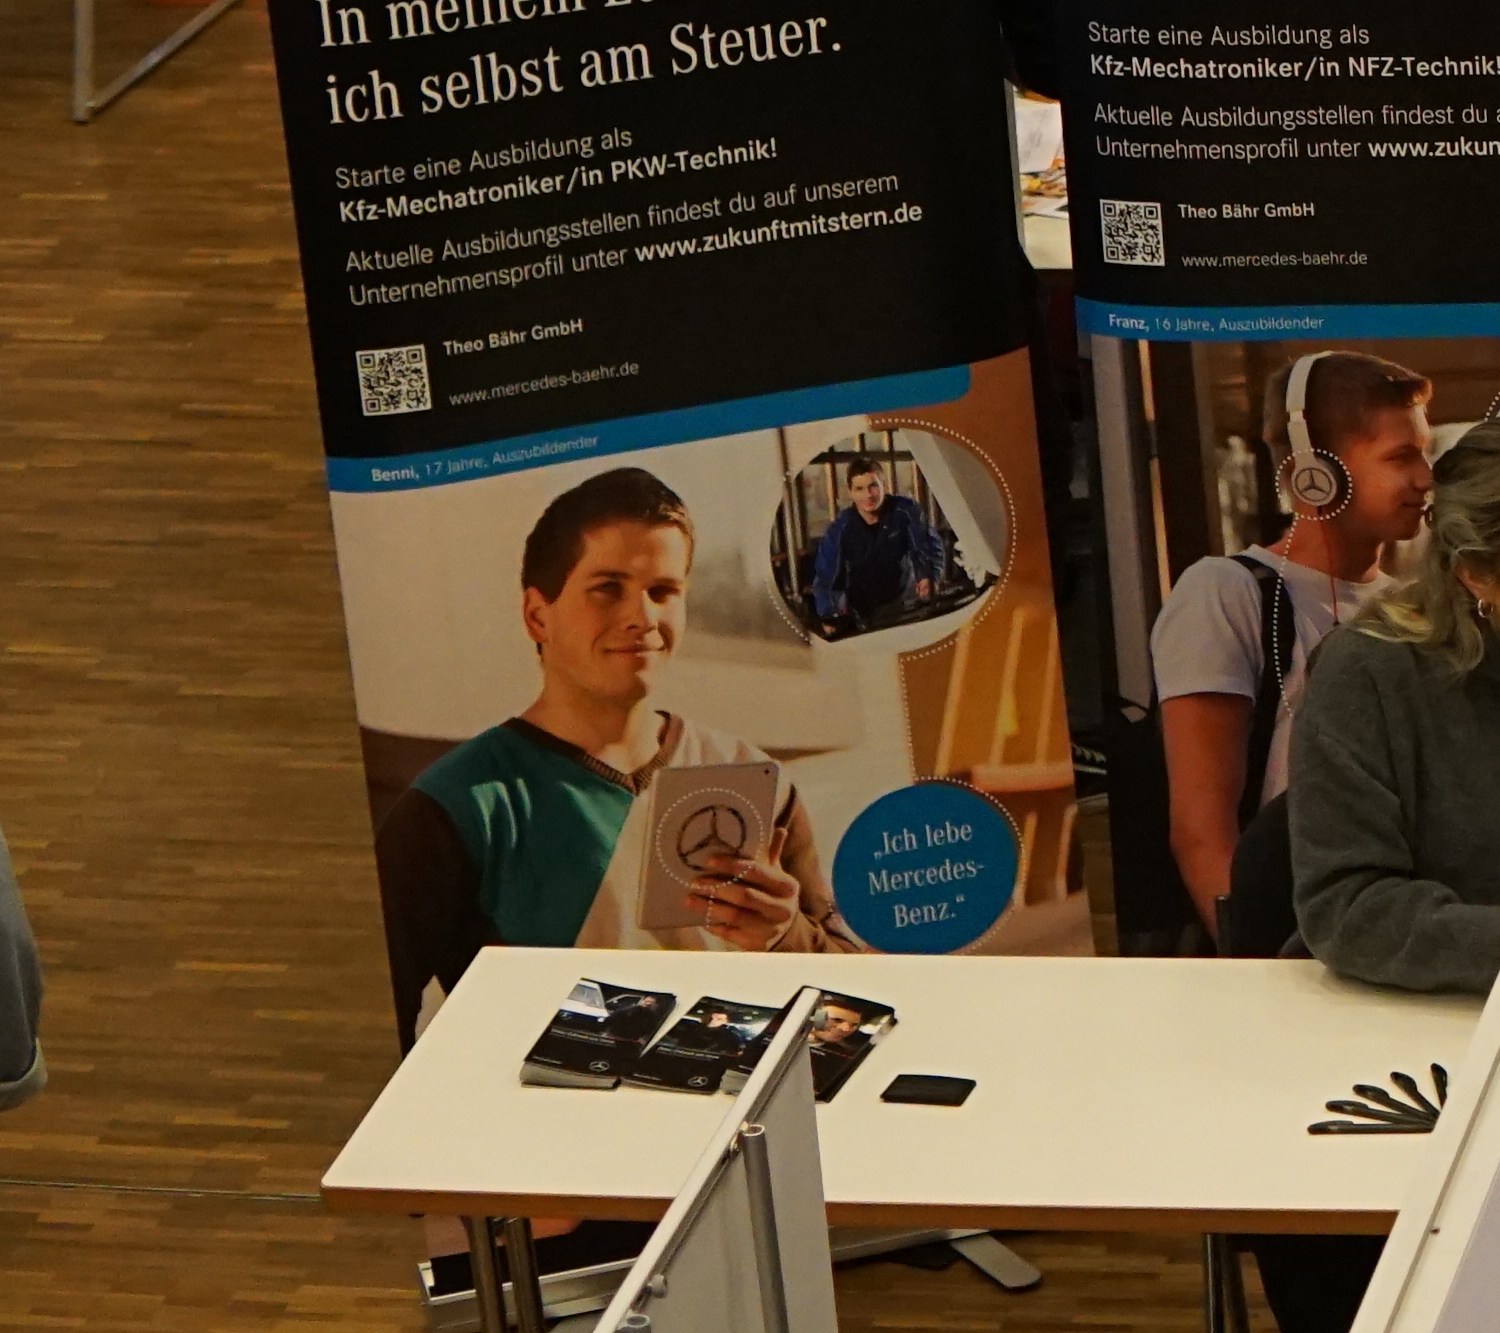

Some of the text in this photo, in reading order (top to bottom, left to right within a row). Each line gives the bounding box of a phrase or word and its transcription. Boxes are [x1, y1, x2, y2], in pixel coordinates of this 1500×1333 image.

[325, 16, 841, 124] ich selbst am Steuer.
[1090, 53, 1340, 82] Kfz-Mechatroniker/in
[335, 126, 633, 189] Starte eine Ausbildung als
[339, 136, 777, 223] Kfz-Mechatroniker/in PKW-Technik!
[345, 174, 899, 272] Aktuelle Ausbildungsstellen findest du auf unserem
[349, 201, 923, 306] Unternehmensprofil unter www.zukunftmitstern.de
[442, 318, 584, 356] Theo Bähr GmbH
[448, 361, 639, 406] www.mercedes-baehr.de
[925, 821, 973, 848] lebe
[868, 858, 986, 895] Mercedes-
